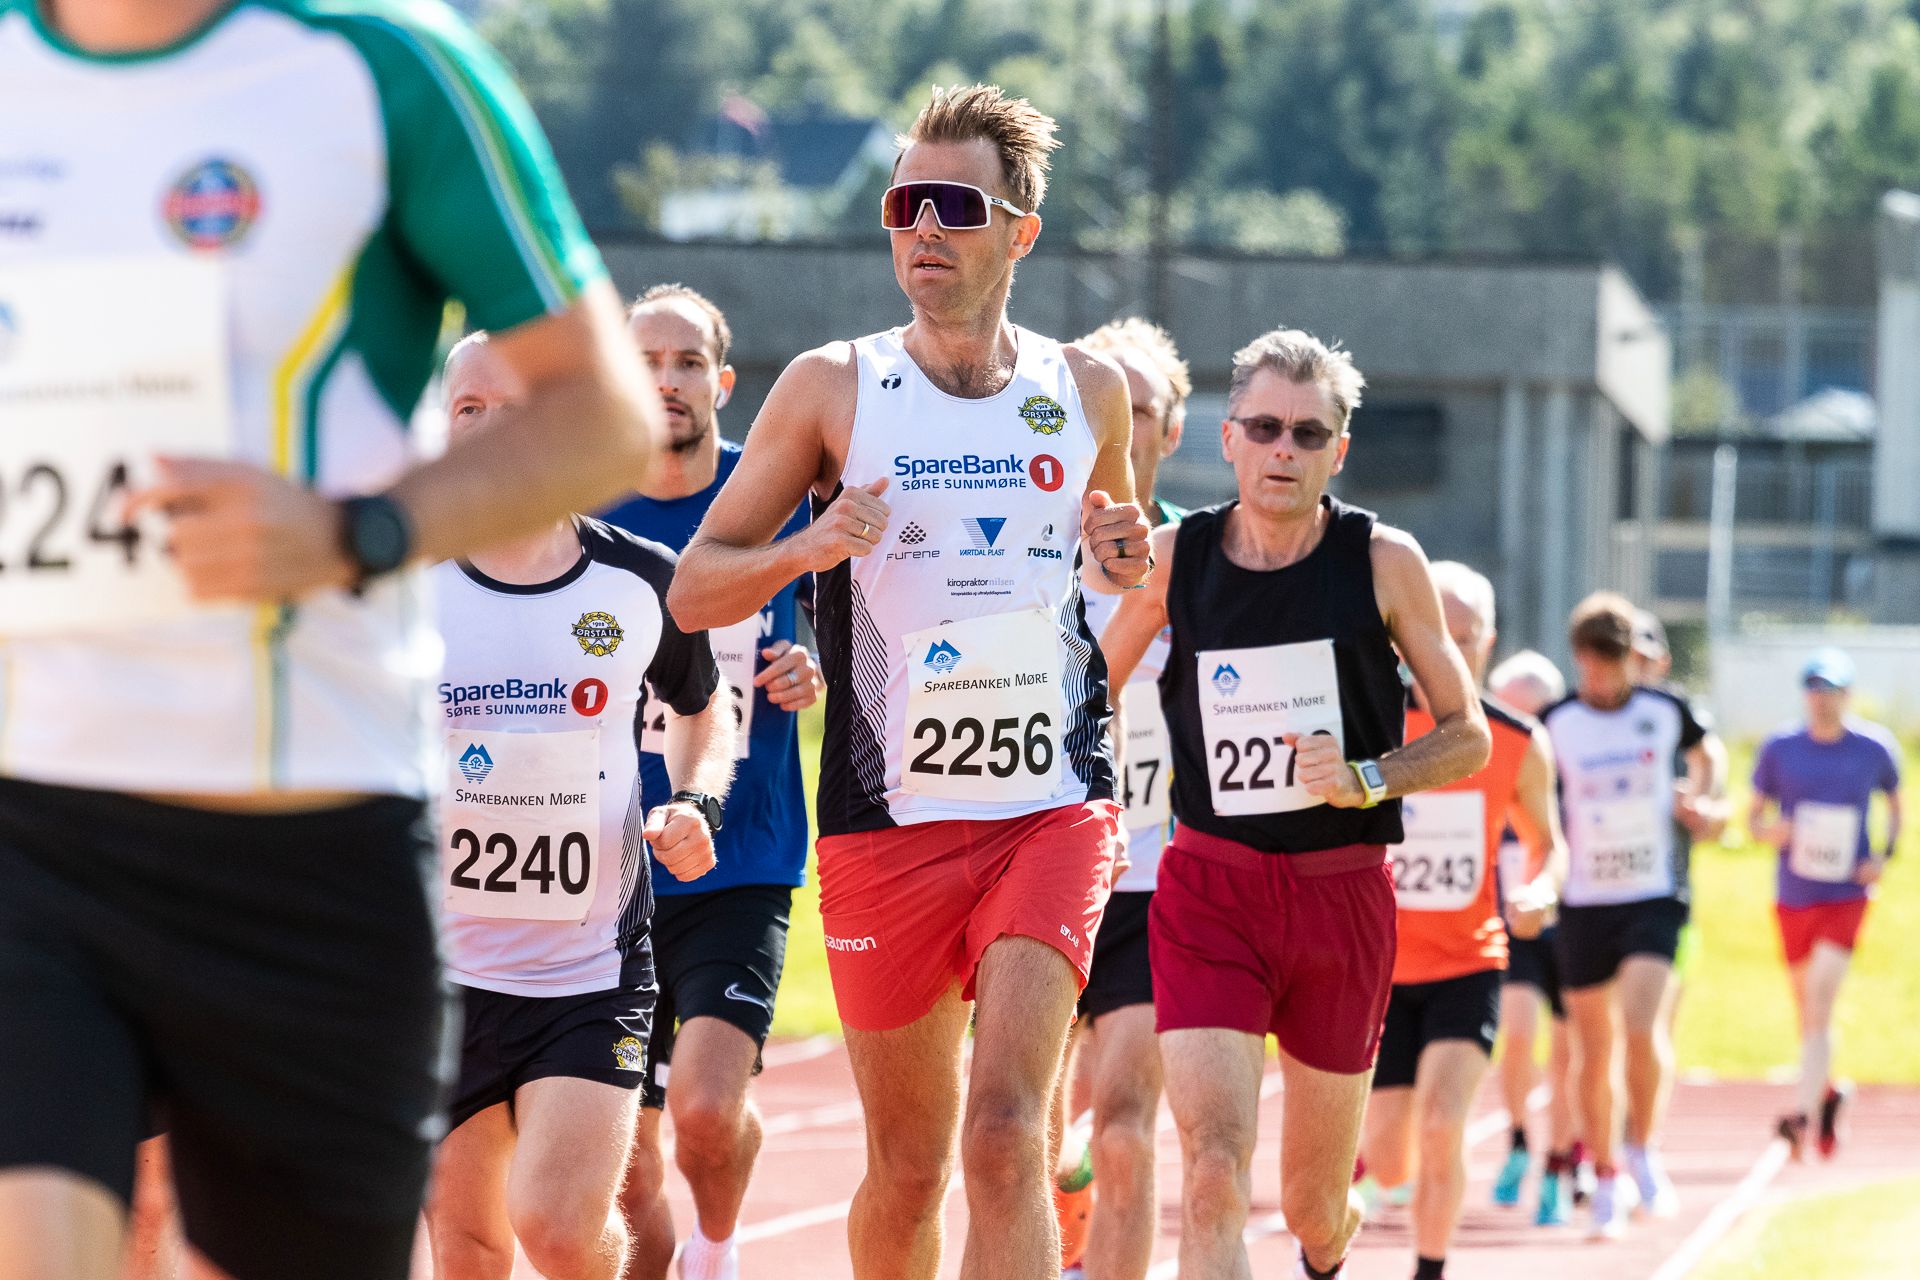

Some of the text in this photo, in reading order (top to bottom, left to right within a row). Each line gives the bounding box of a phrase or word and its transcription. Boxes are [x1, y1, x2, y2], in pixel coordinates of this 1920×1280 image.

[894, 454, 1053, 485] SpareBank 1
[902, 478, 1027, 491] SØRE SUNNMØRE
[1027, 547, 1063, 560] TUSSA
[576, 629, 607, 637] ØRSTA
[437, 678, 598, 709] SpareBank 1
[924, 672, 1048, 693] SPAREBANKEN MØRE
[446, 704, 567, 718] SØRE SUNNMØRE
[909, 712, 1053, 778] 2256
[1214, 729, 1332, 792] 227
[455, 789, 587, 806] SPAREBANKEN MØRE
[450, 828, 590, 895] 2240
[1393, 855, 1475, 892] 2243
